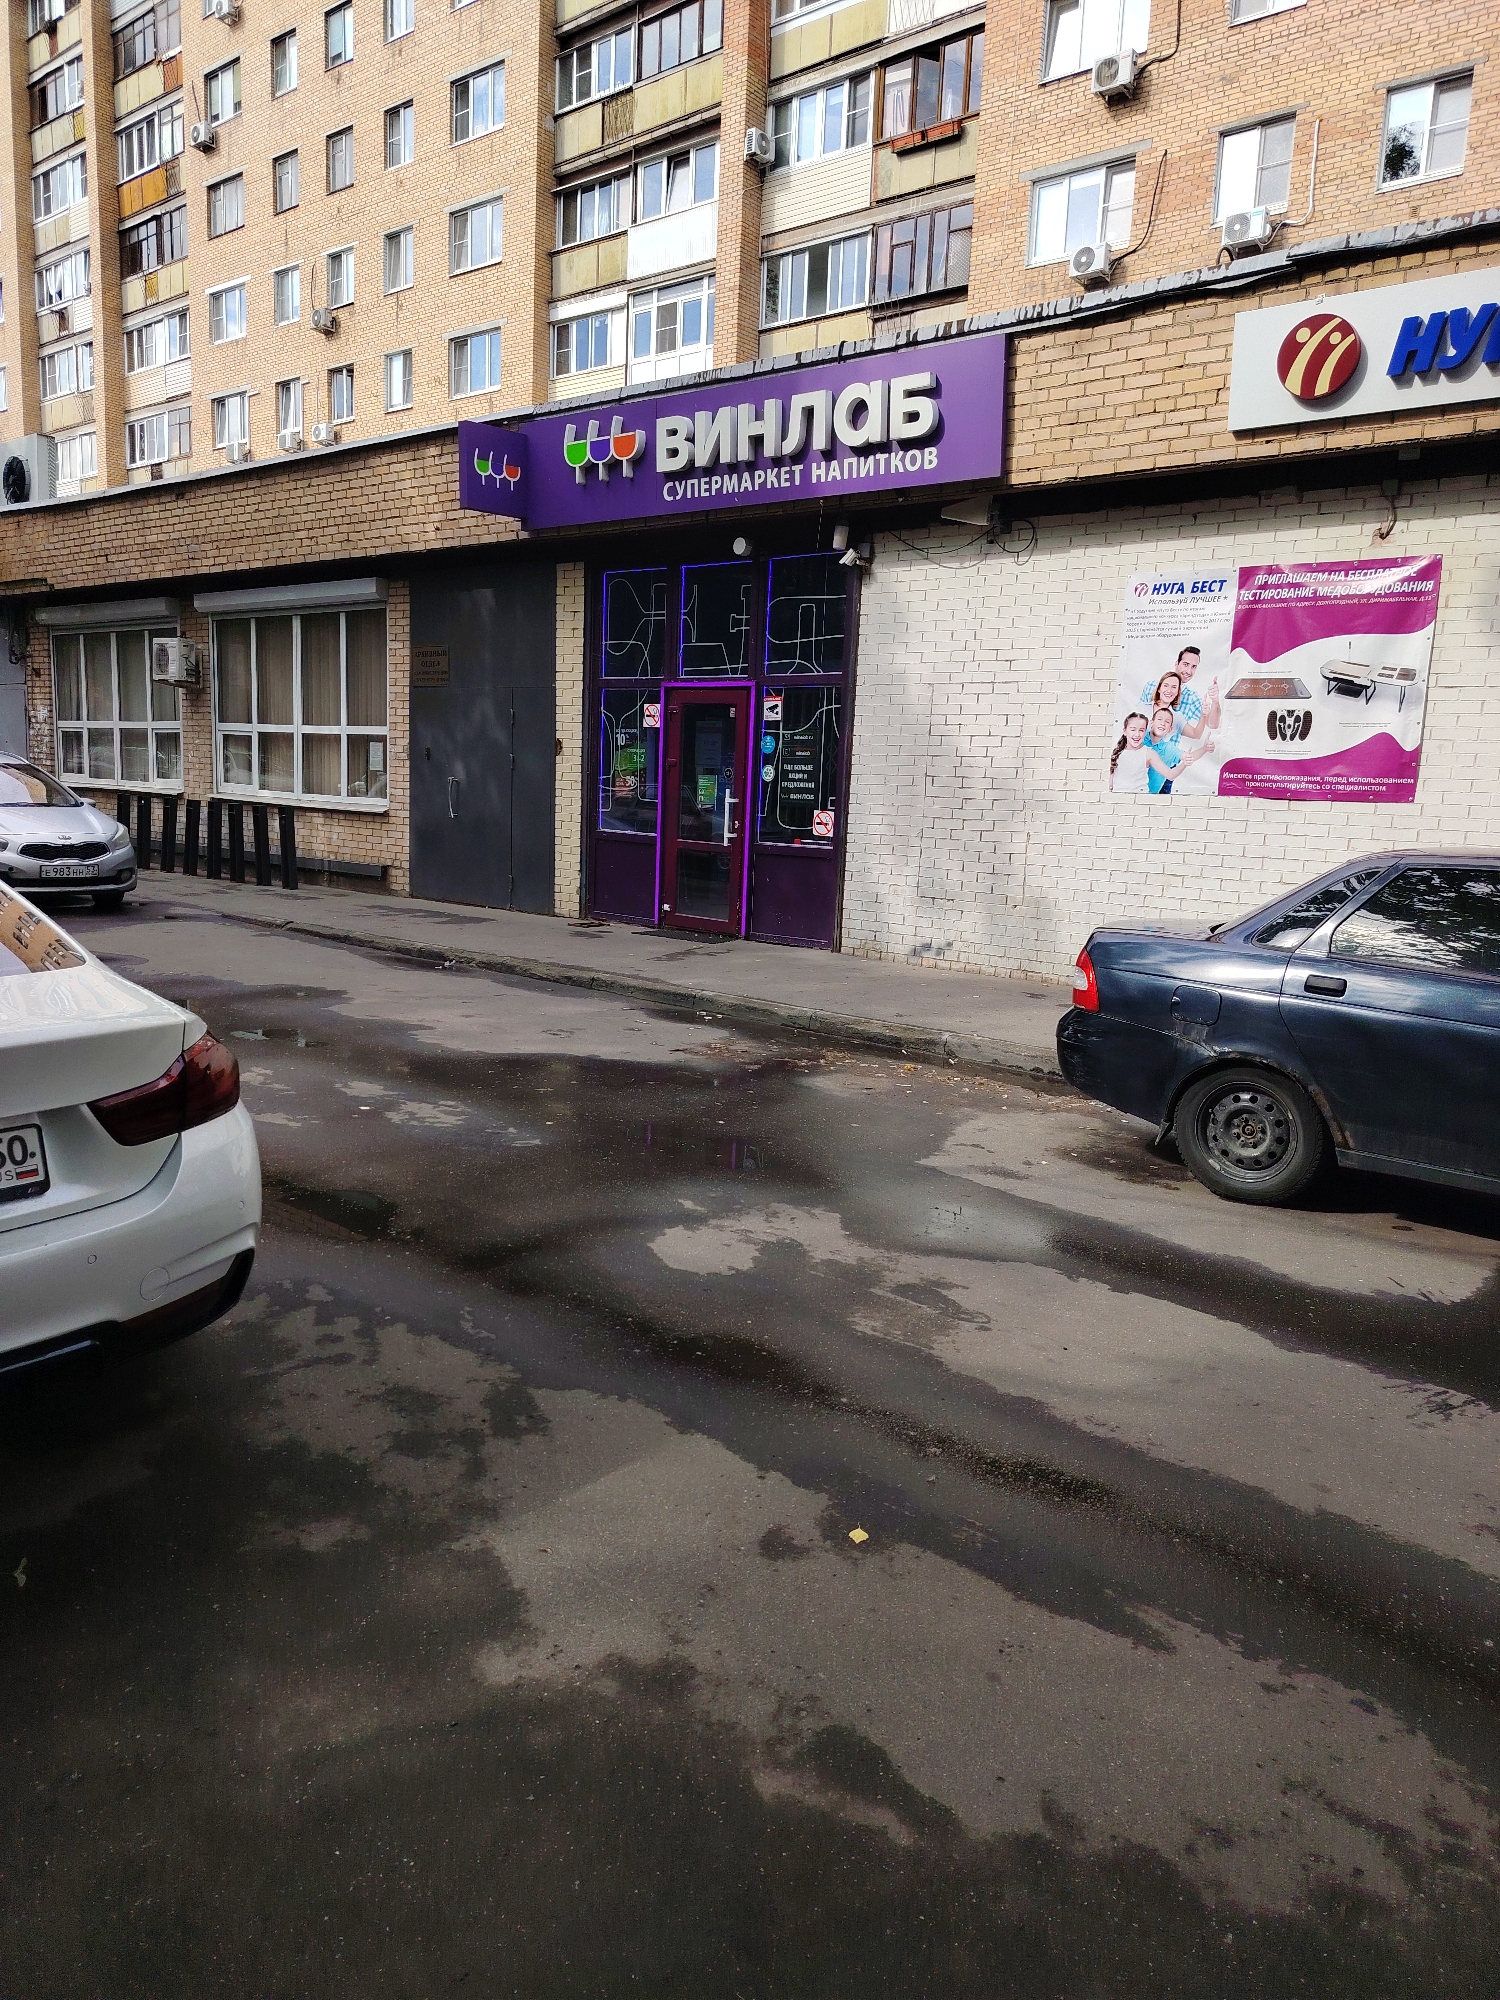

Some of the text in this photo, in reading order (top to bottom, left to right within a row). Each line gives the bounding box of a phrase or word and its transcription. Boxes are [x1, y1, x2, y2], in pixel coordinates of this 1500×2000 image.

[662, 446, 939, 502] СУПЕРМАРКЕТ НАПИТКОВ
[1254, 572, 1328, 585] ПРИГЛАШАЕМ
[1329, 571, 1344, 582] НА
[1151, 579, 1227, 595] НУГА БЕСТ
[1239, 586, 1315, 601] ТЕСТИРОВАНИЕ
[1148, 597, 1189, 605] Используй
[1253, 774, 1322, 782] противопоказания,
[1331, 783, 1386, 791] специалистом
